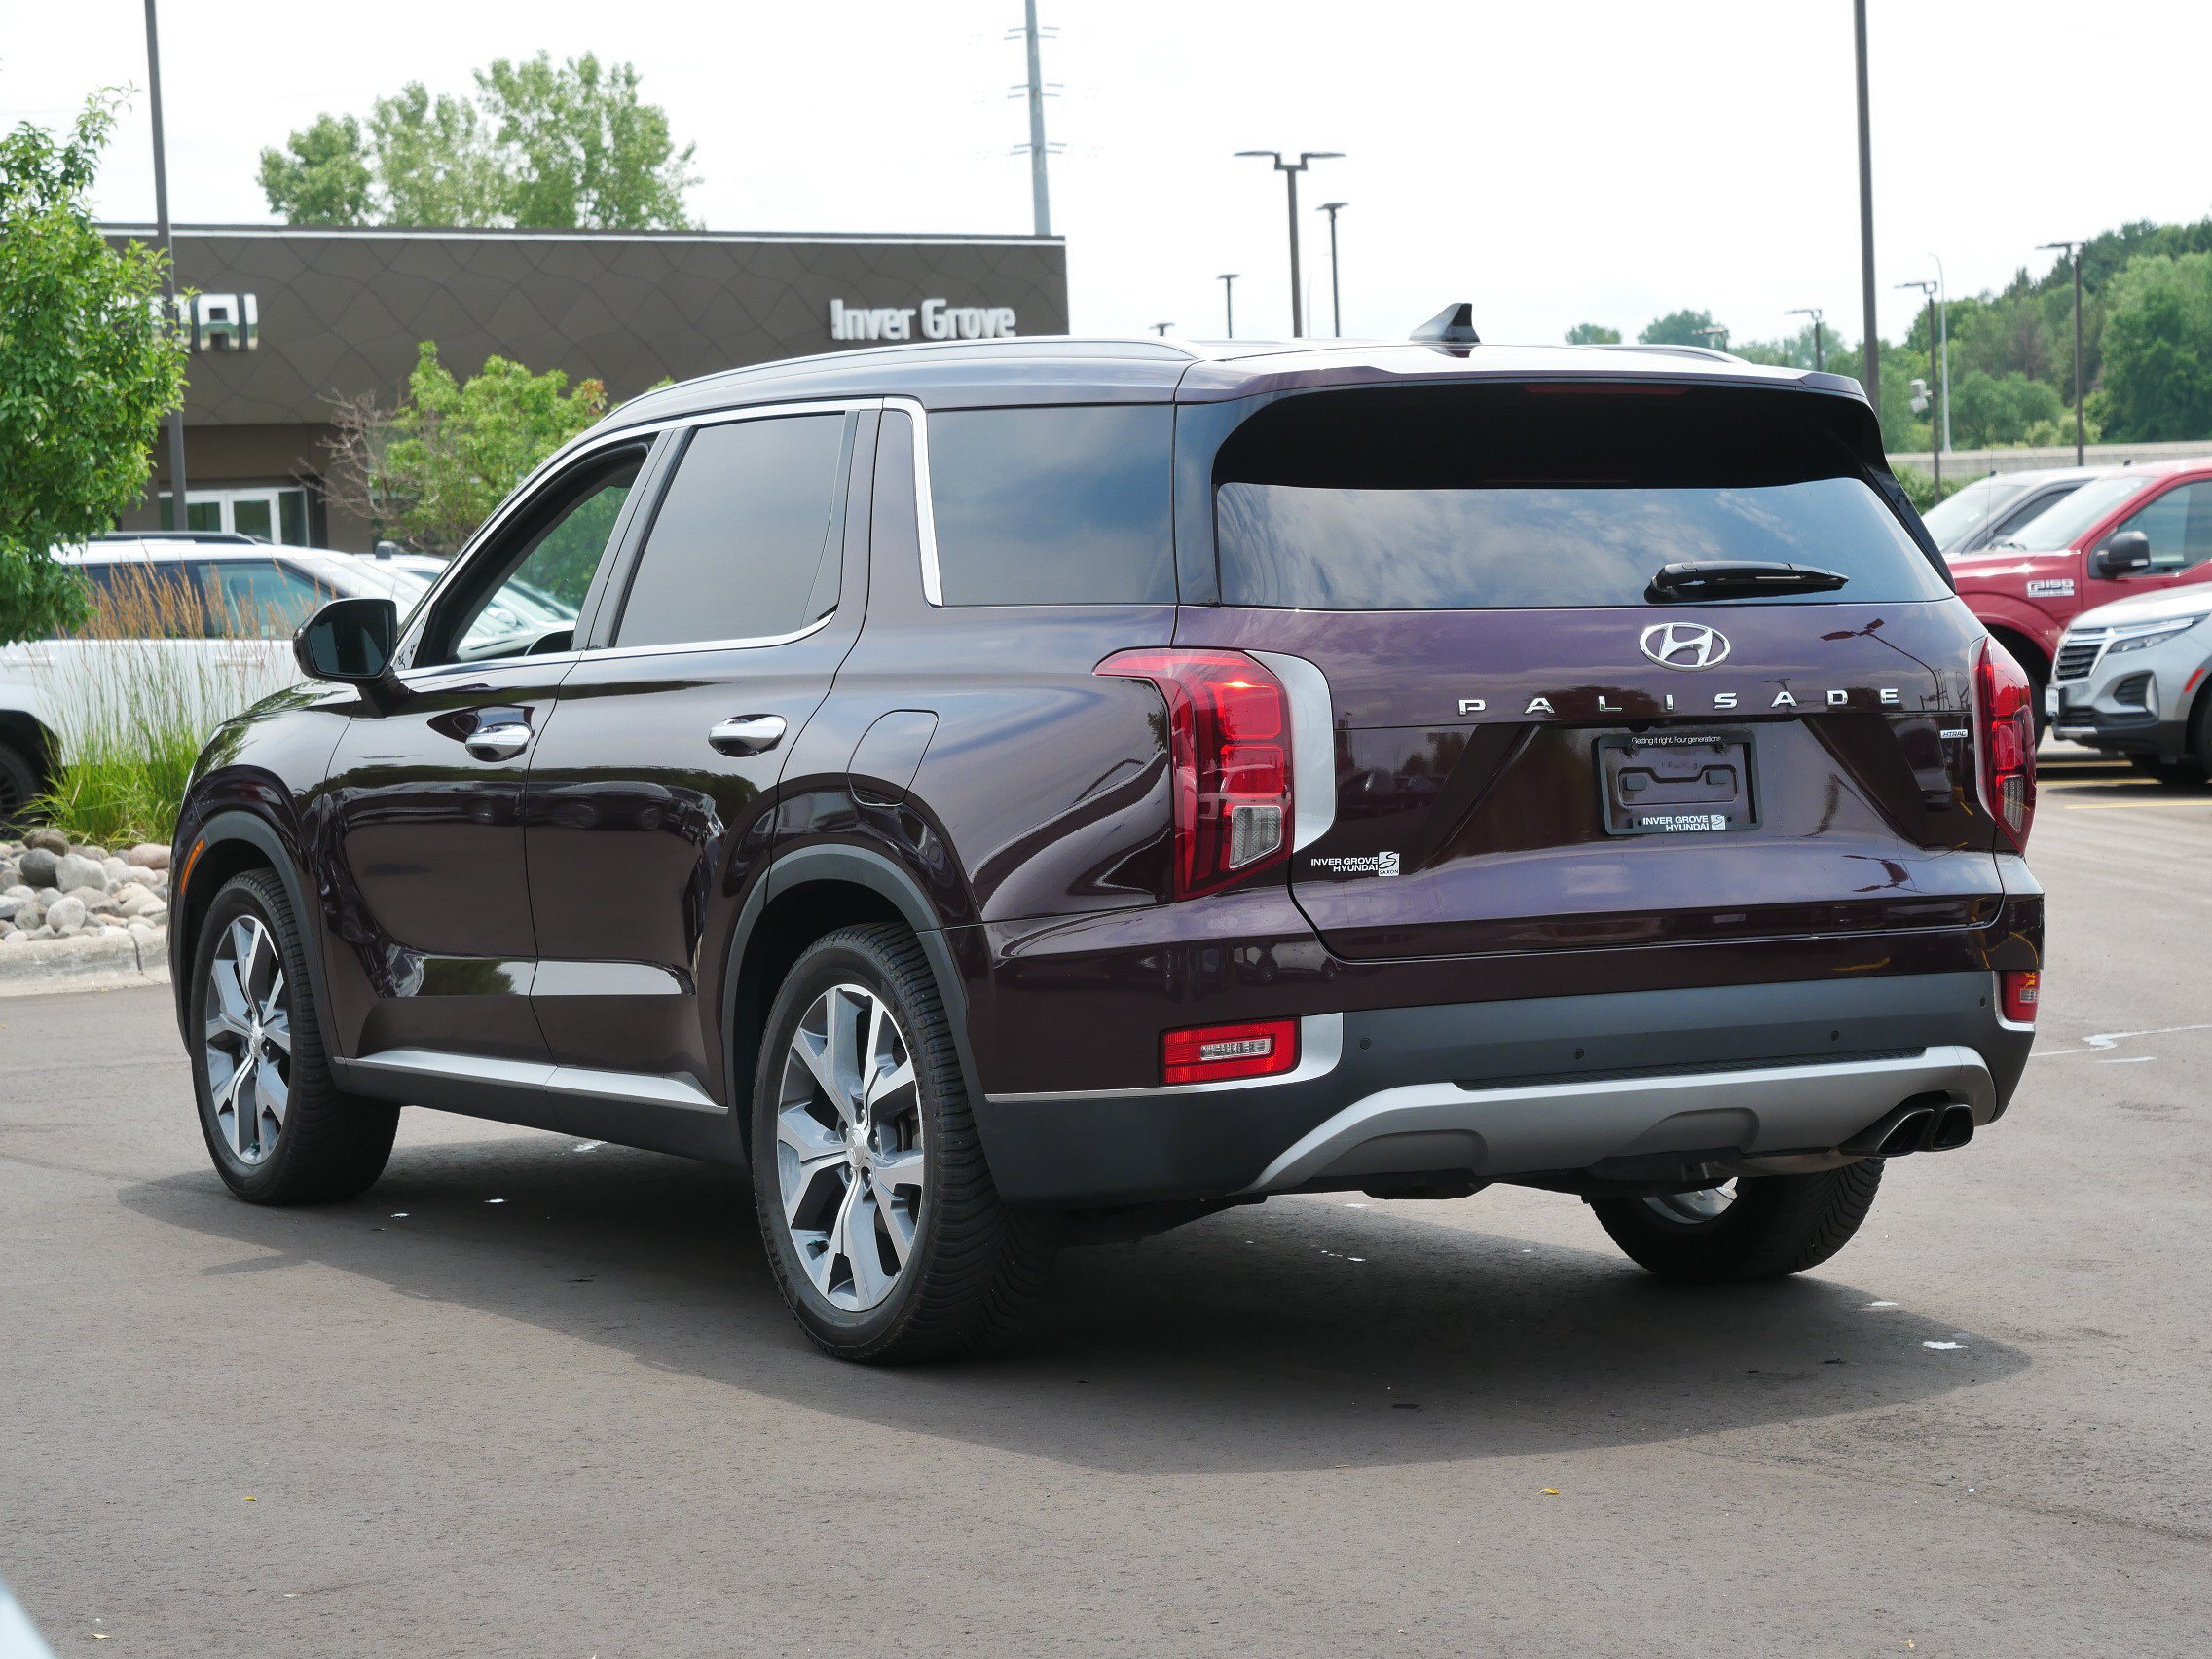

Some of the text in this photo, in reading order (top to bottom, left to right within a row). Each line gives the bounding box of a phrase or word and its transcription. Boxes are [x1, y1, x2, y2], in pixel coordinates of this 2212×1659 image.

[830, 298, 1016, 340] Inver Grove
[1458, 688, 1899, 715] PALISADE
[1642, 815, 1709, 825] INVER GROVE
